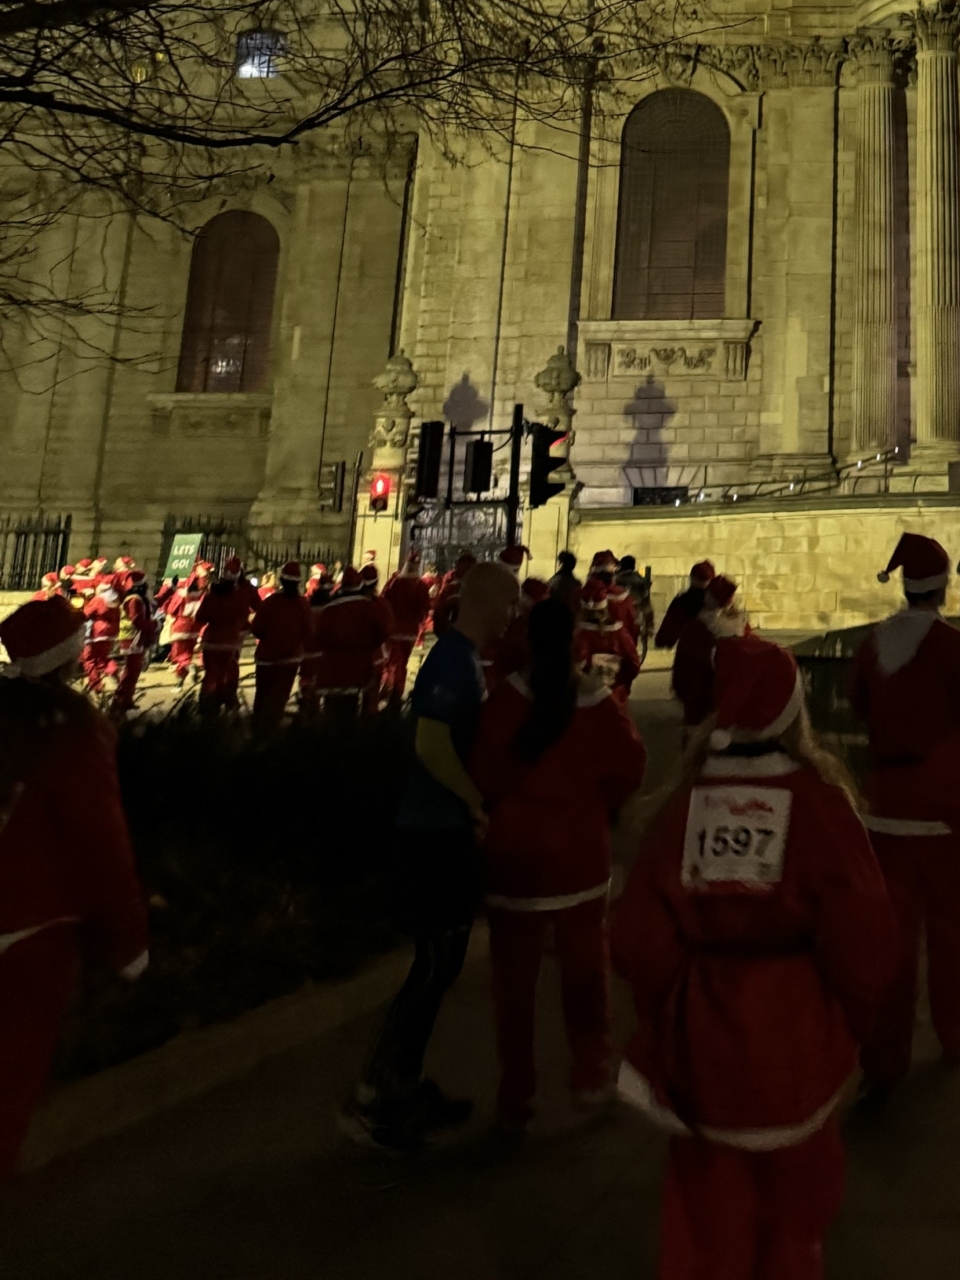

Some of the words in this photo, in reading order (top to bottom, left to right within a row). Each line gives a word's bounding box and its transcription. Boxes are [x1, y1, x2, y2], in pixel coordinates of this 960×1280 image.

[173, 544, 195, 555] LETS
[171, 558, 190, 570] GO!
[697, 825, 775, 858] 1597
